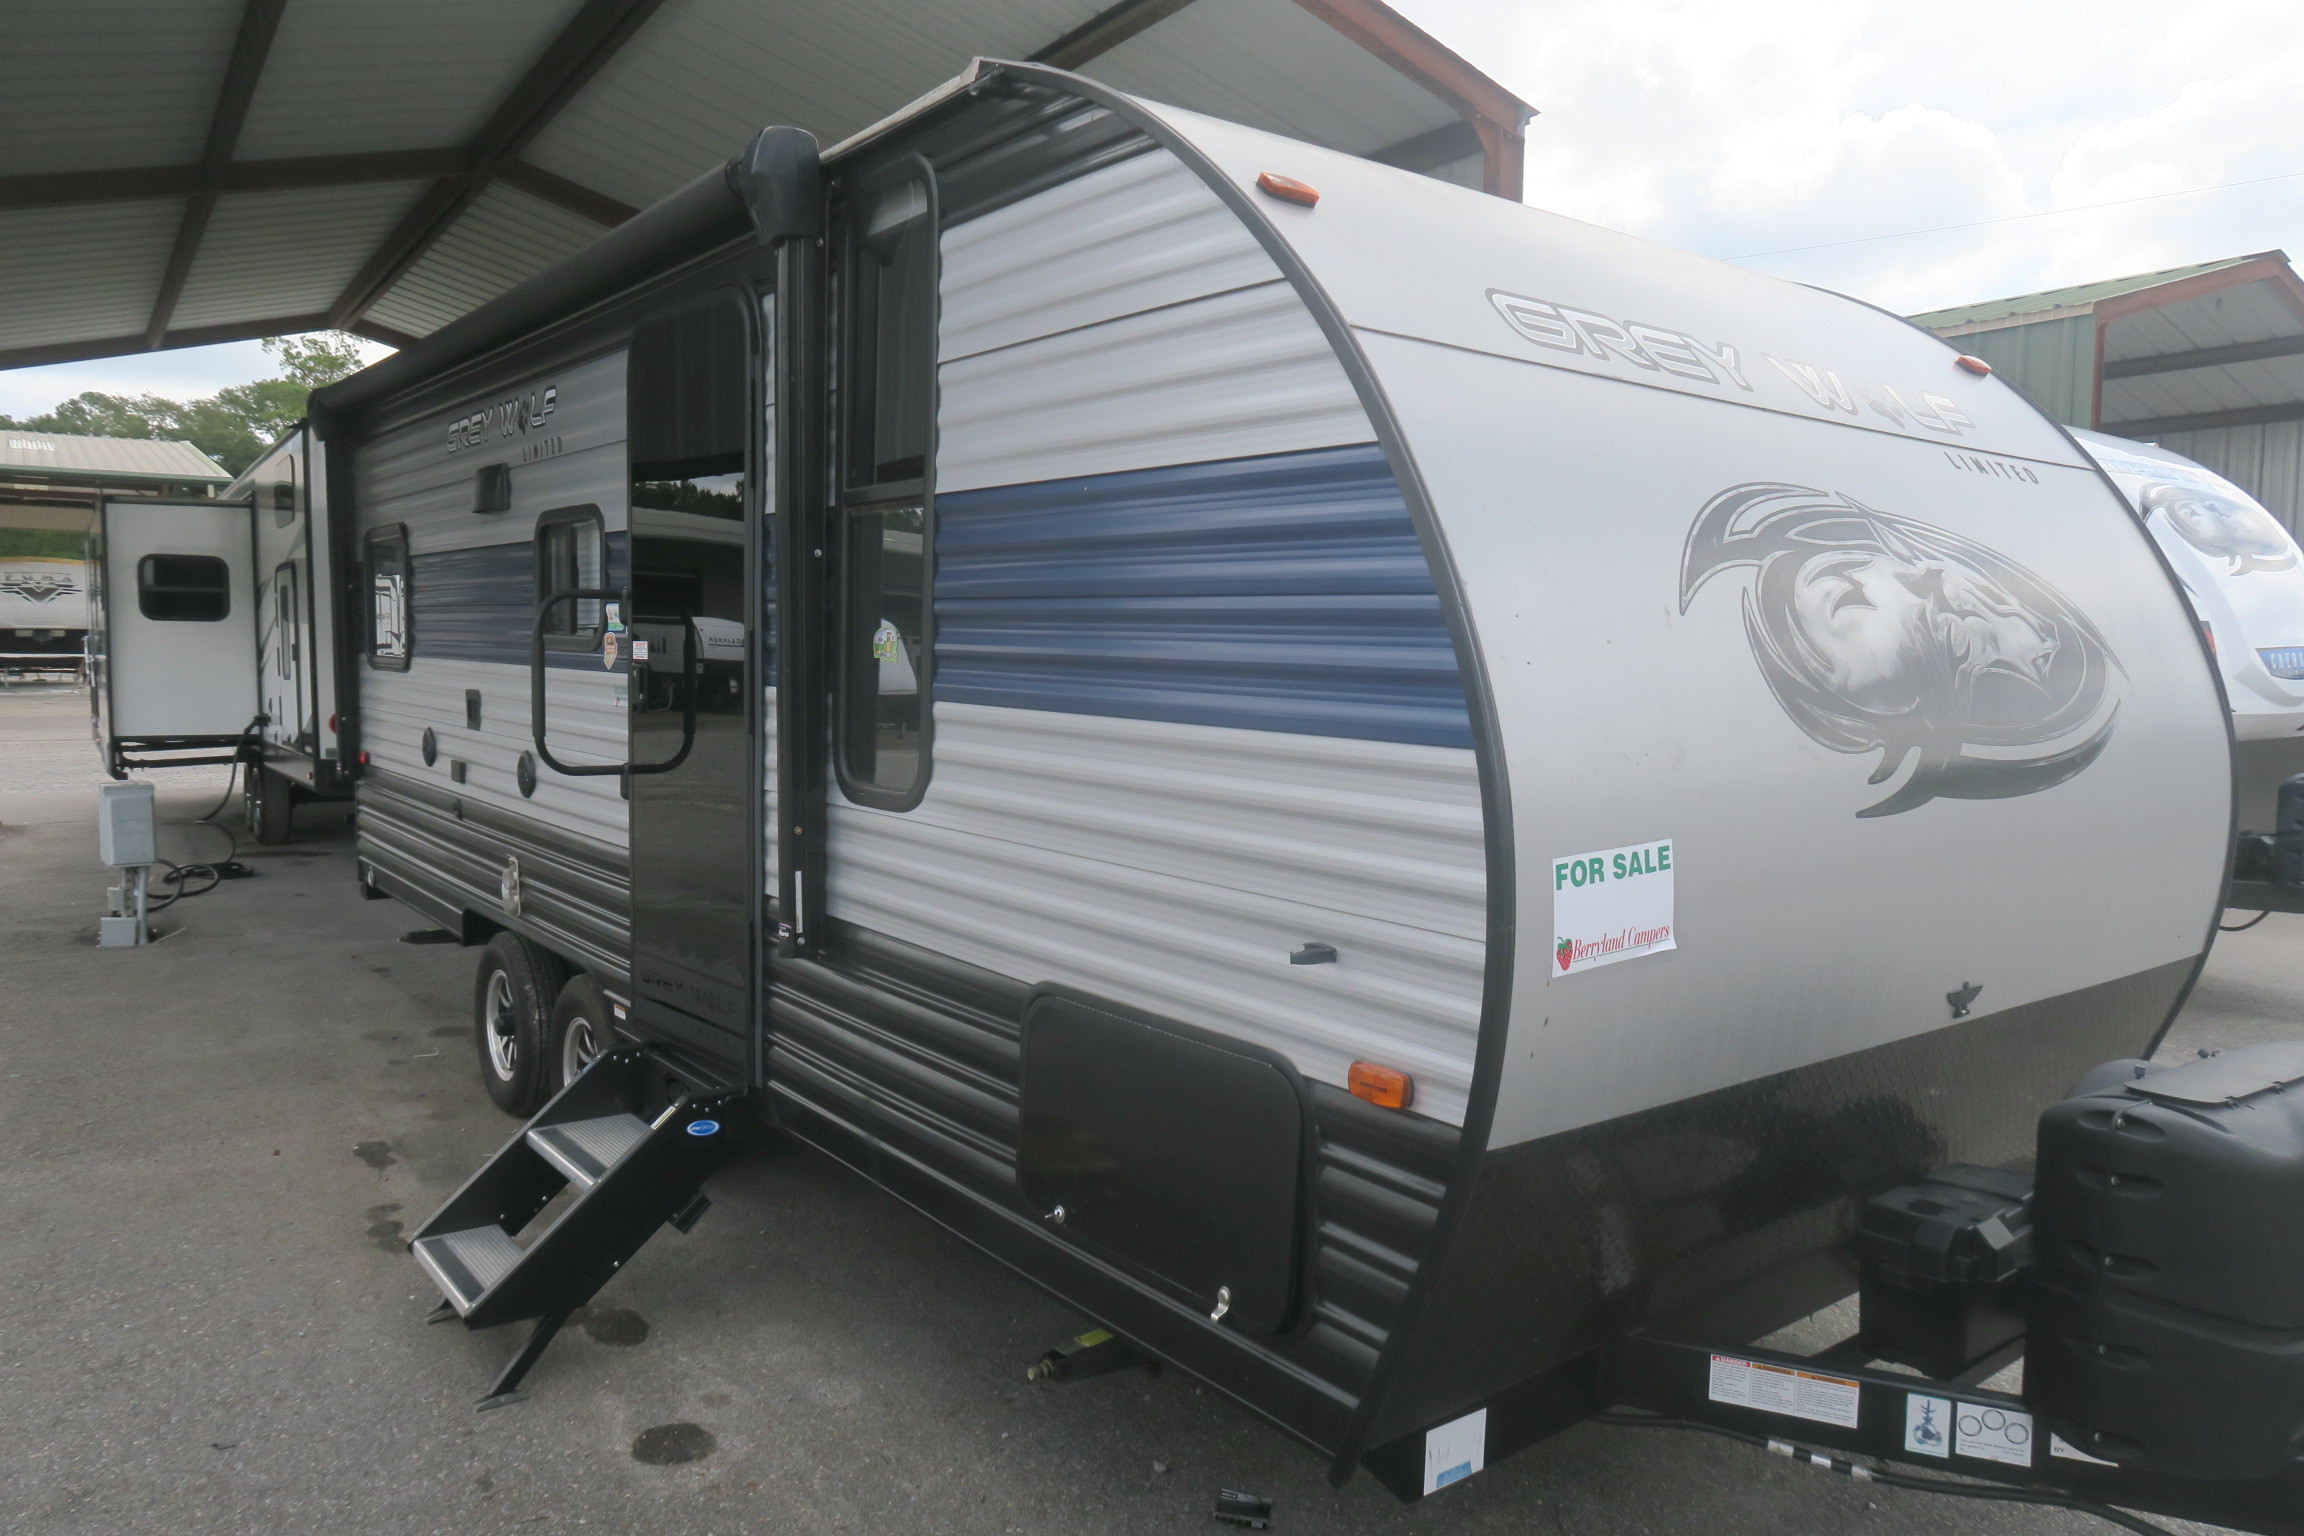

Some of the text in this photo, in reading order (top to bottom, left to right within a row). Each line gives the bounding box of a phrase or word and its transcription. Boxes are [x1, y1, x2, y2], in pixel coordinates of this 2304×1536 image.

[1484, 287, 1754, 392] GREY
[447, 406, 494, 455] GREY
[522, 436, 563, 462] LIMITED
[1942, 450, 2041, 485] LIMITED
[1555, 845, 1671, 891] FOR SALE
[1572, 925, 1671, 962] Berryland Campers
[1720, 1356, 1748, 1367] DANGER
